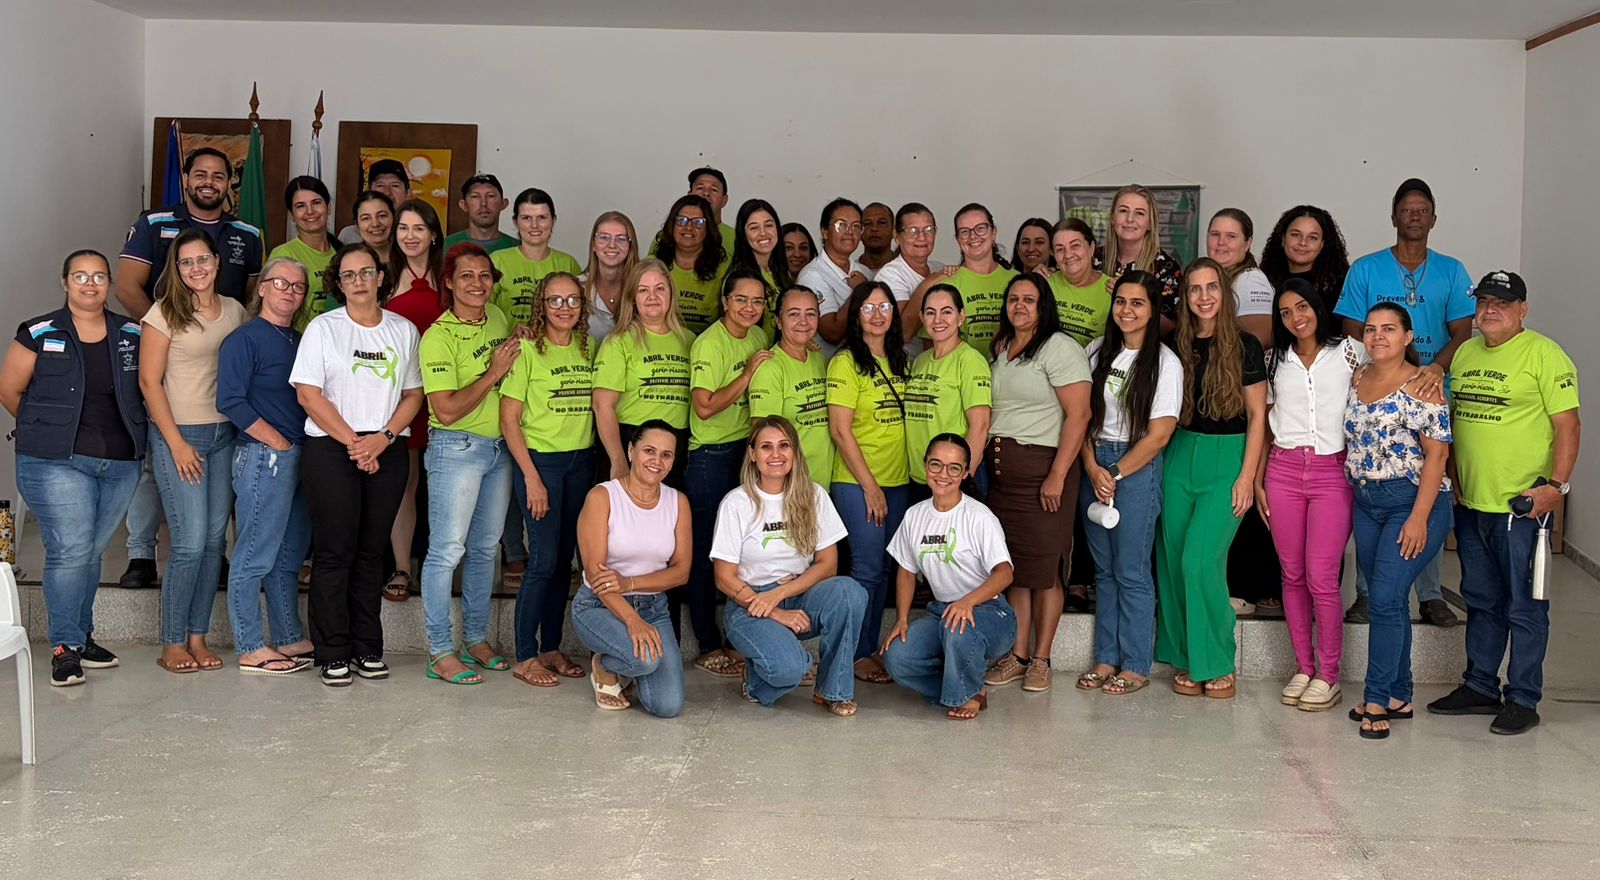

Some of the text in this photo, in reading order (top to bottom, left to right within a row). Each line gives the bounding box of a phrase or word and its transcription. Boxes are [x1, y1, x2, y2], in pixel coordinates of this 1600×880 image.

[680, 290, 705, 301] VERDE
[1070, 303, 1096, 316] VERDE
[353, 349, 387, 360] ABRIL
[643, 354, 665, 364] ABRIL
[1483, 369, 1508, 382] VERDE
[762, 521, 788, 532] ABRI
